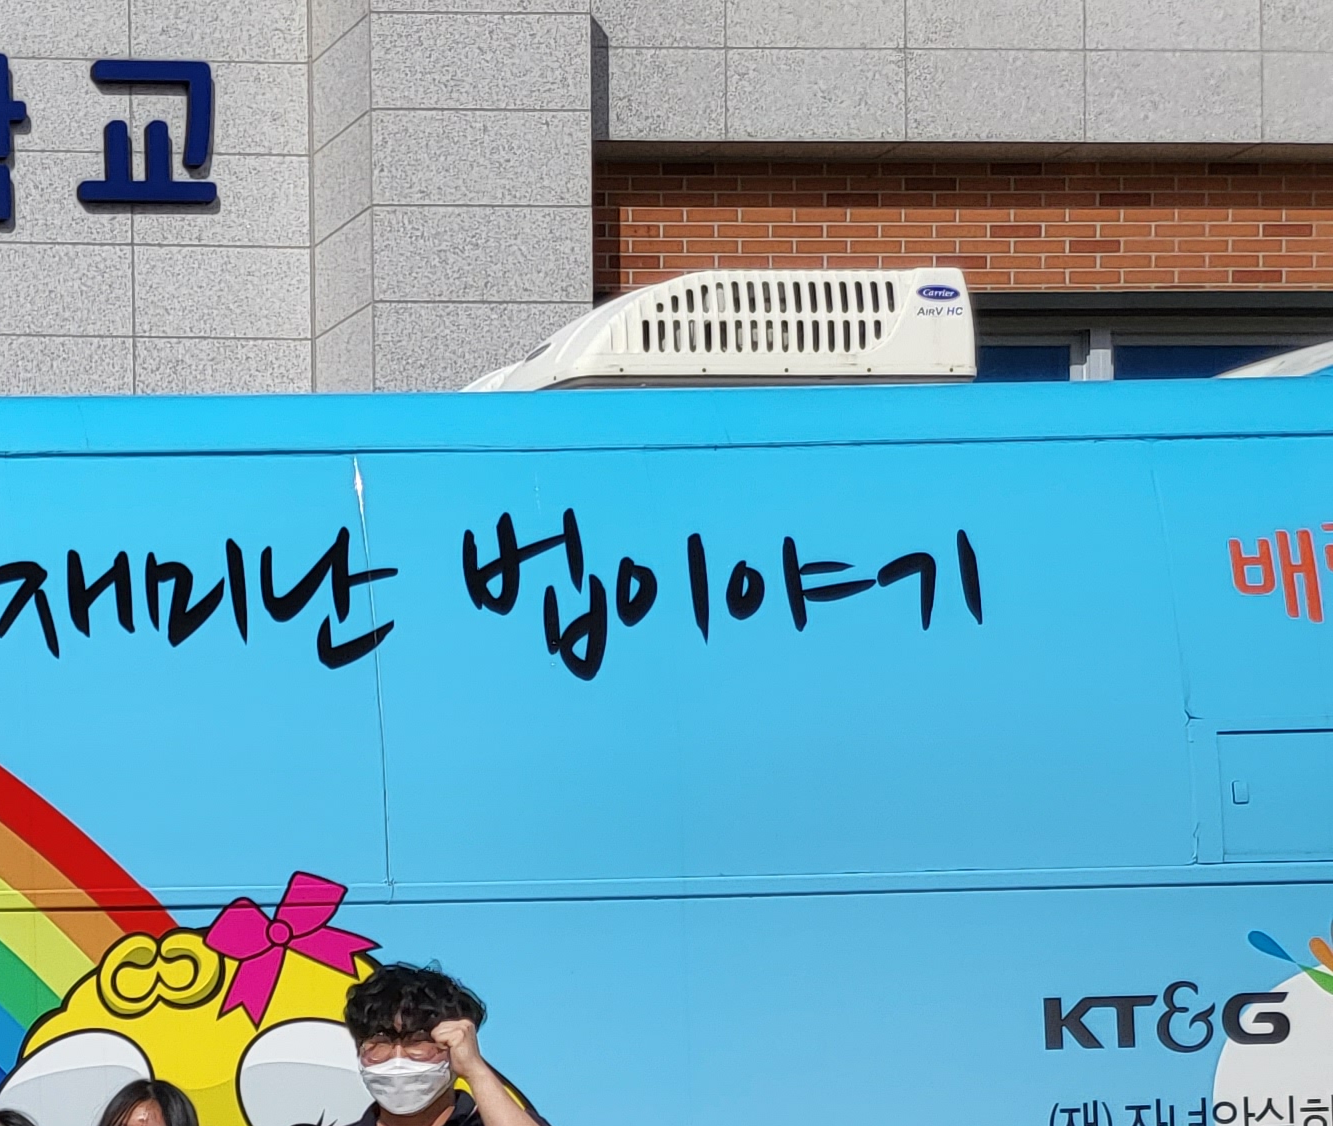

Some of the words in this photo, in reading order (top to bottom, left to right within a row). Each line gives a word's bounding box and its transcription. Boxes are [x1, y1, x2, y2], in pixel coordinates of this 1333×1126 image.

[920, 287, 957, 298] Carrier
[947, 306, 963, 316] HC
[461, 507, 984, 681] 법이야기
[1227, 520, 1333, 624] 배
[1042, 980, 1291, 1053] KT&G
